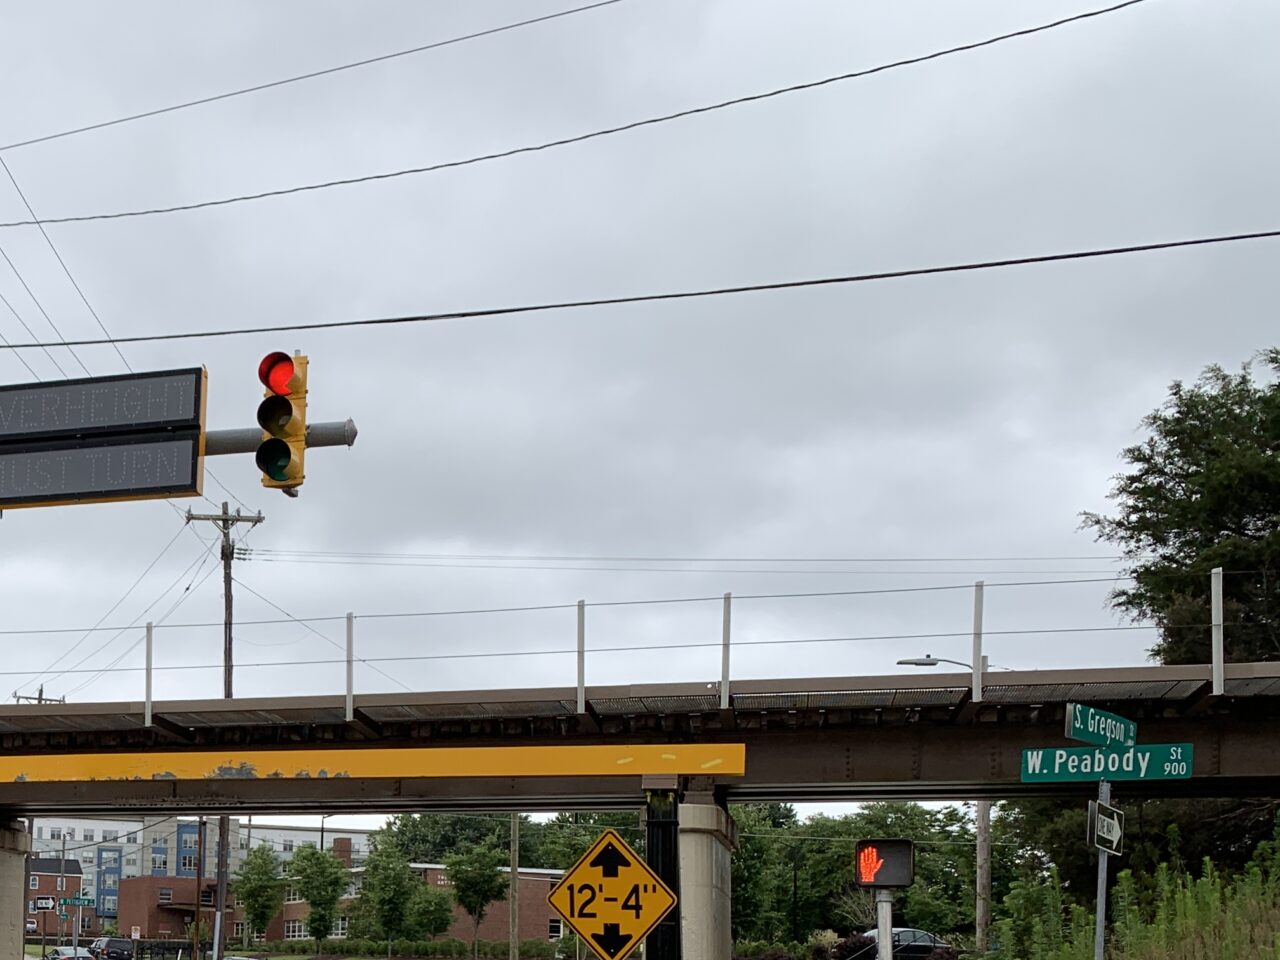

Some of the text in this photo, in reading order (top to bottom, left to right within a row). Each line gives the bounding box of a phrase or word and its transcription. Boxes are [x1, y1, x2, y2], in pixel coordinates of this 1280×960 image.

[85, 447, 178, 486] TURN
[1074, 704, 1084, 729] S.
[1088, 708, 1125, 744] Gregson
[1027, 747, 1183, 778] W. Peabody St
[1163, 762, 1188, 775] 900
